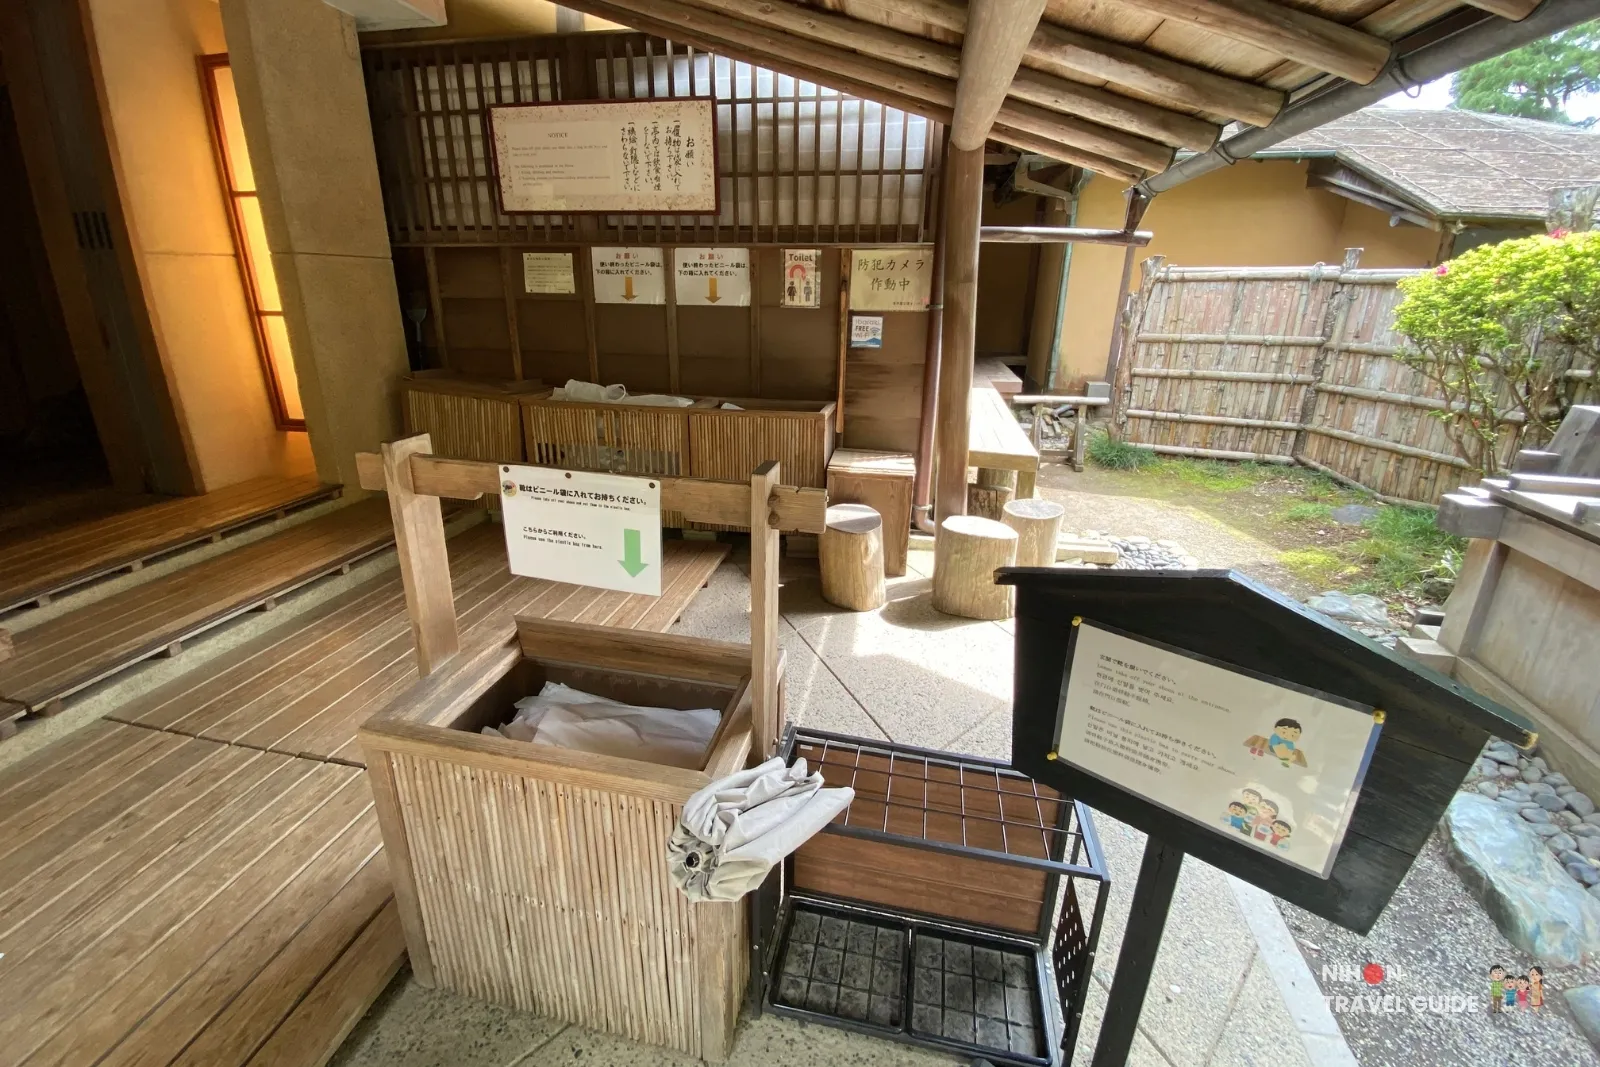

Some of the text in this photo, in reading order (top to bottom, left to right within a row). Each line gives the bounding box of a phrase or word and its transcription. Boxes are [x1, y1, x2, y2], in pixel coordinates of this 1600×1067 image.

[685, 136, 695, 168] お願い
[789, 253, 813, 262] Toilet
[857, 258, 925, 271] 防犯カメラ
[871, 277, 911, 292] 作動中
[519, 485, 646, 506] 靴はビニール袋に入れてお持ちください。
[523, 526, 586, 539] こちらからご利用ください。
